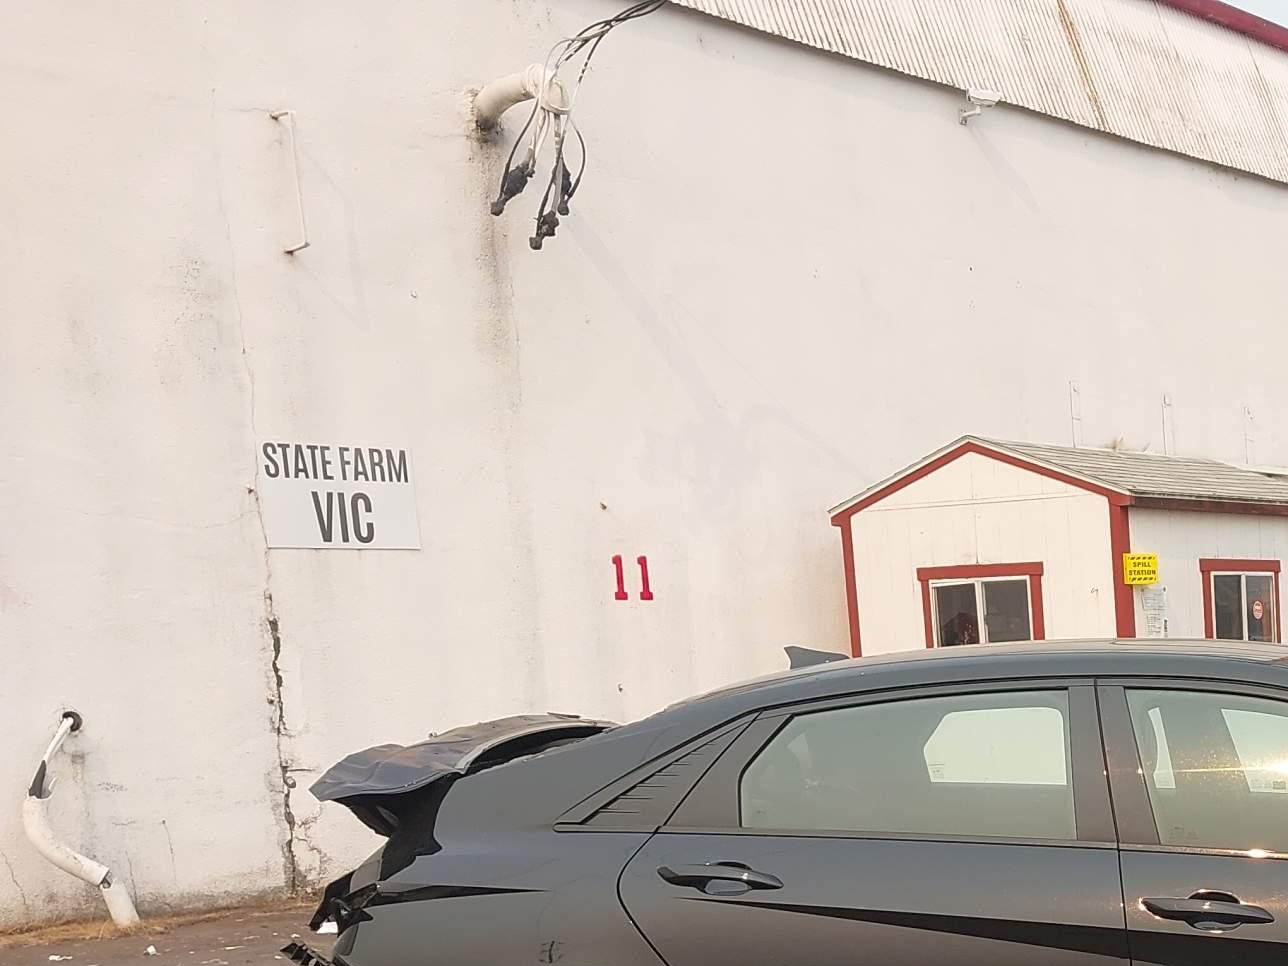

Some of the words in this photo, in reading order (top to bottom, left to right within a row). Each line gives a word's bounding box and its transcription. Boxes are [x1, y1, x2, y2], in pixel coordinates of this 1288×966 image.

[263, 442, 333, 480] STATE
[339, 446, 409, 483] FARM
[311, 490, 375, 543] VIC
[612, 555, 653, 600] 11
